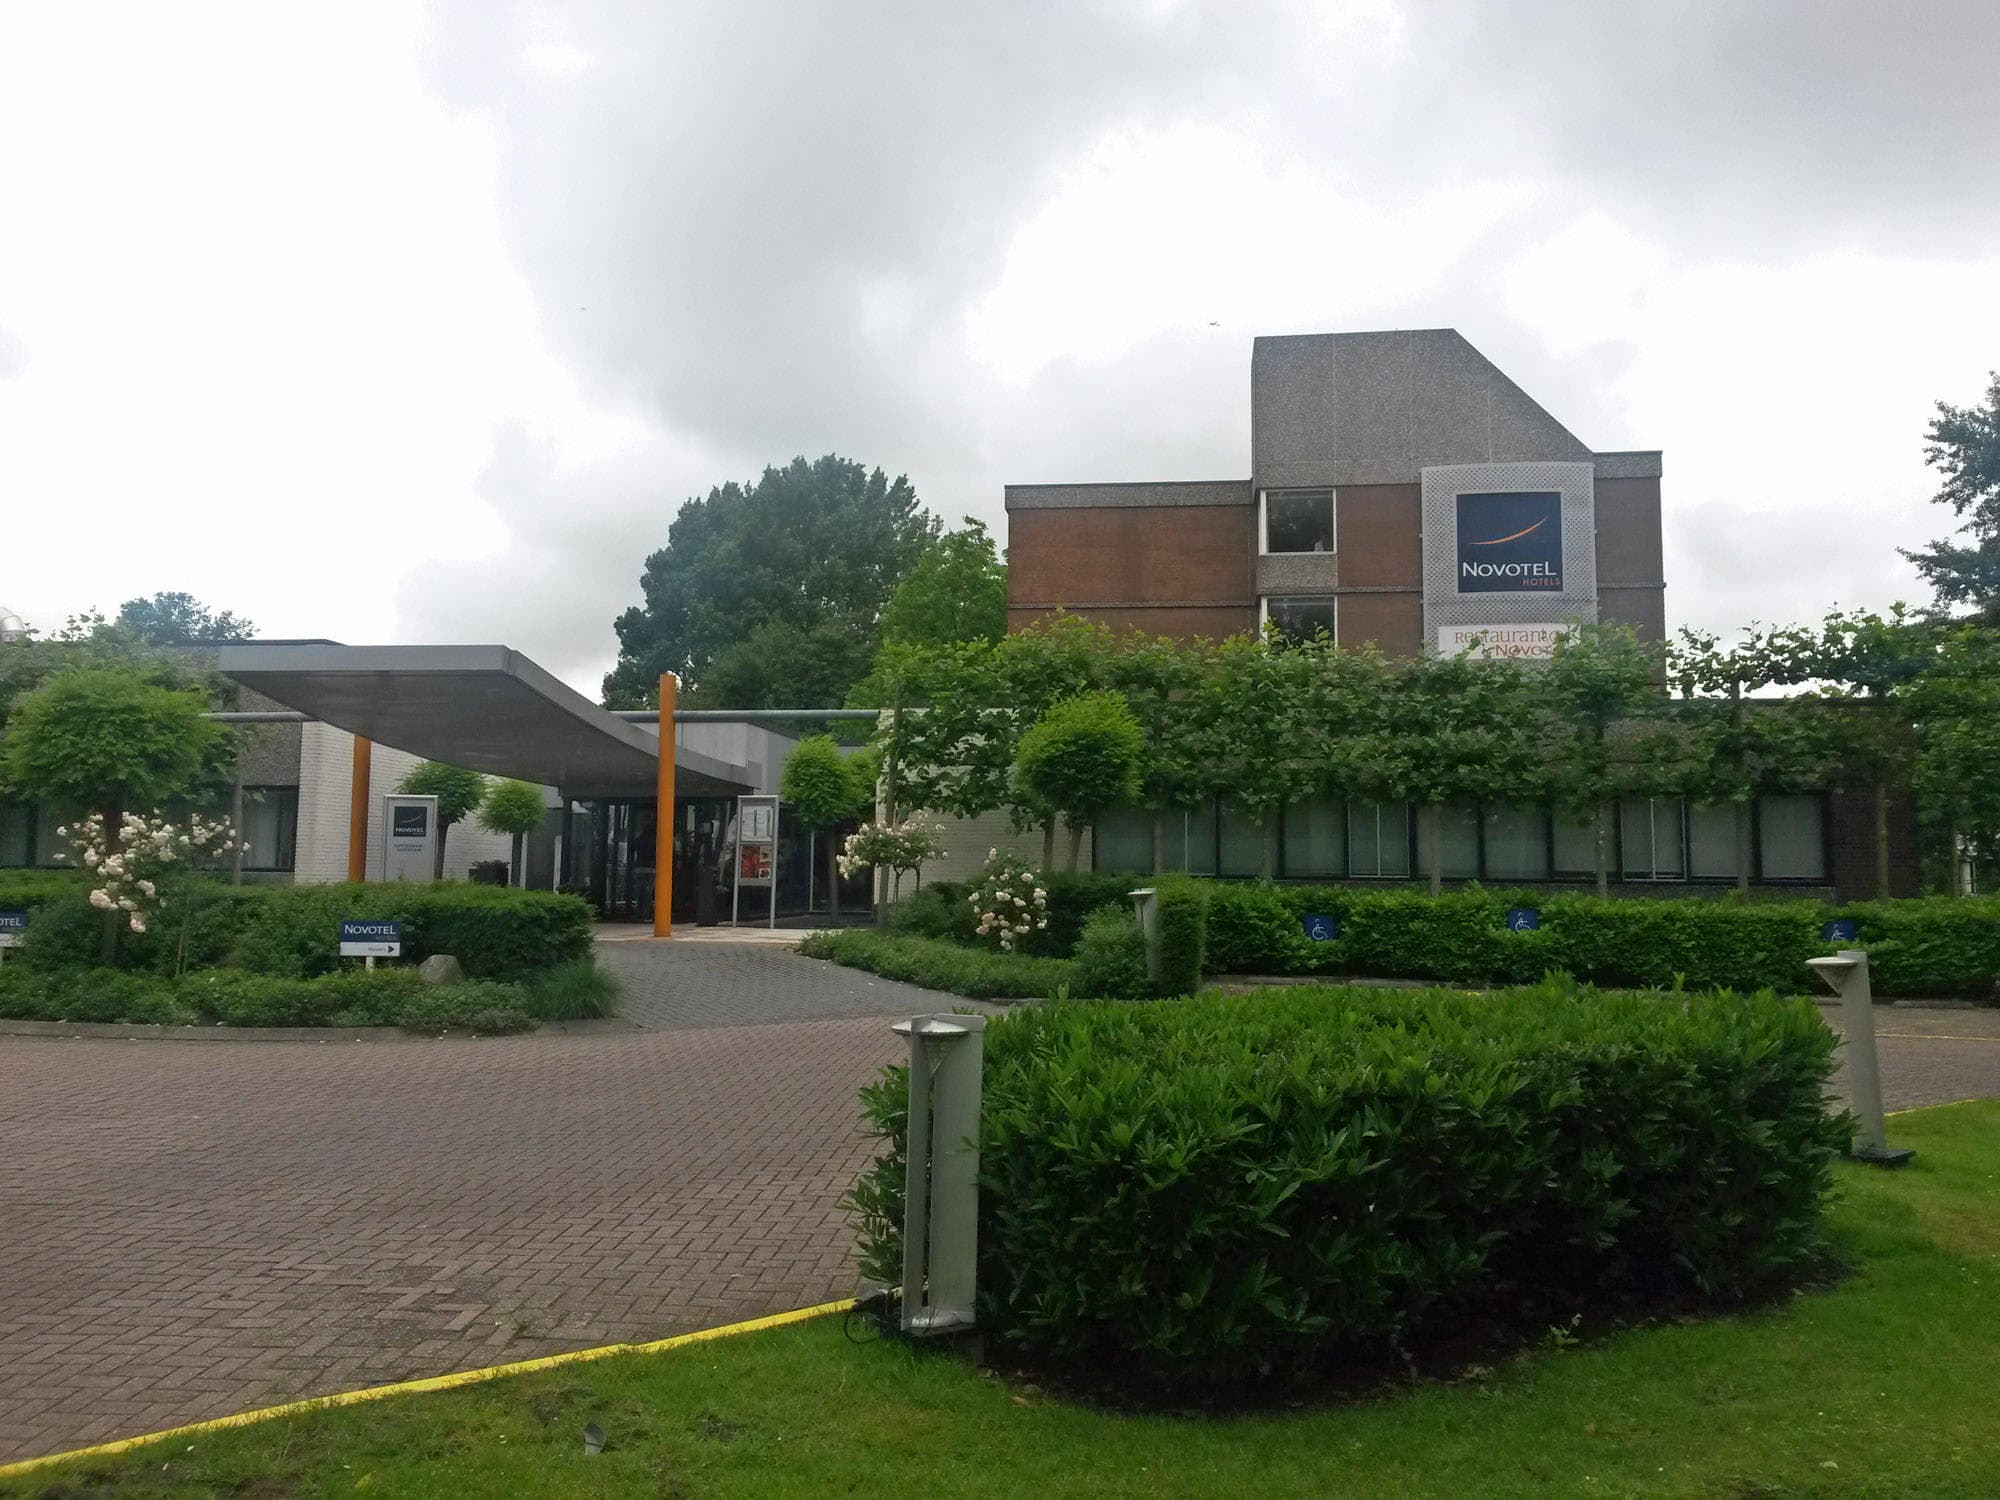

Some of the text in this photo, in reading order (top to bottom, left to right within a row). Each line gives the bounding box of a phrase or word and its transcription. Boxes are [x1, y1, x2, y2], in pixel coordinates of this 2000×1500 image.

[1462, 561, 1557, 577] NOVOTEL
[1522, 577, 1561, 586] HOTELS
[1495, 644, 1553, 656] NOVOT
[344, 924, 397, 935] NOVOTEL
